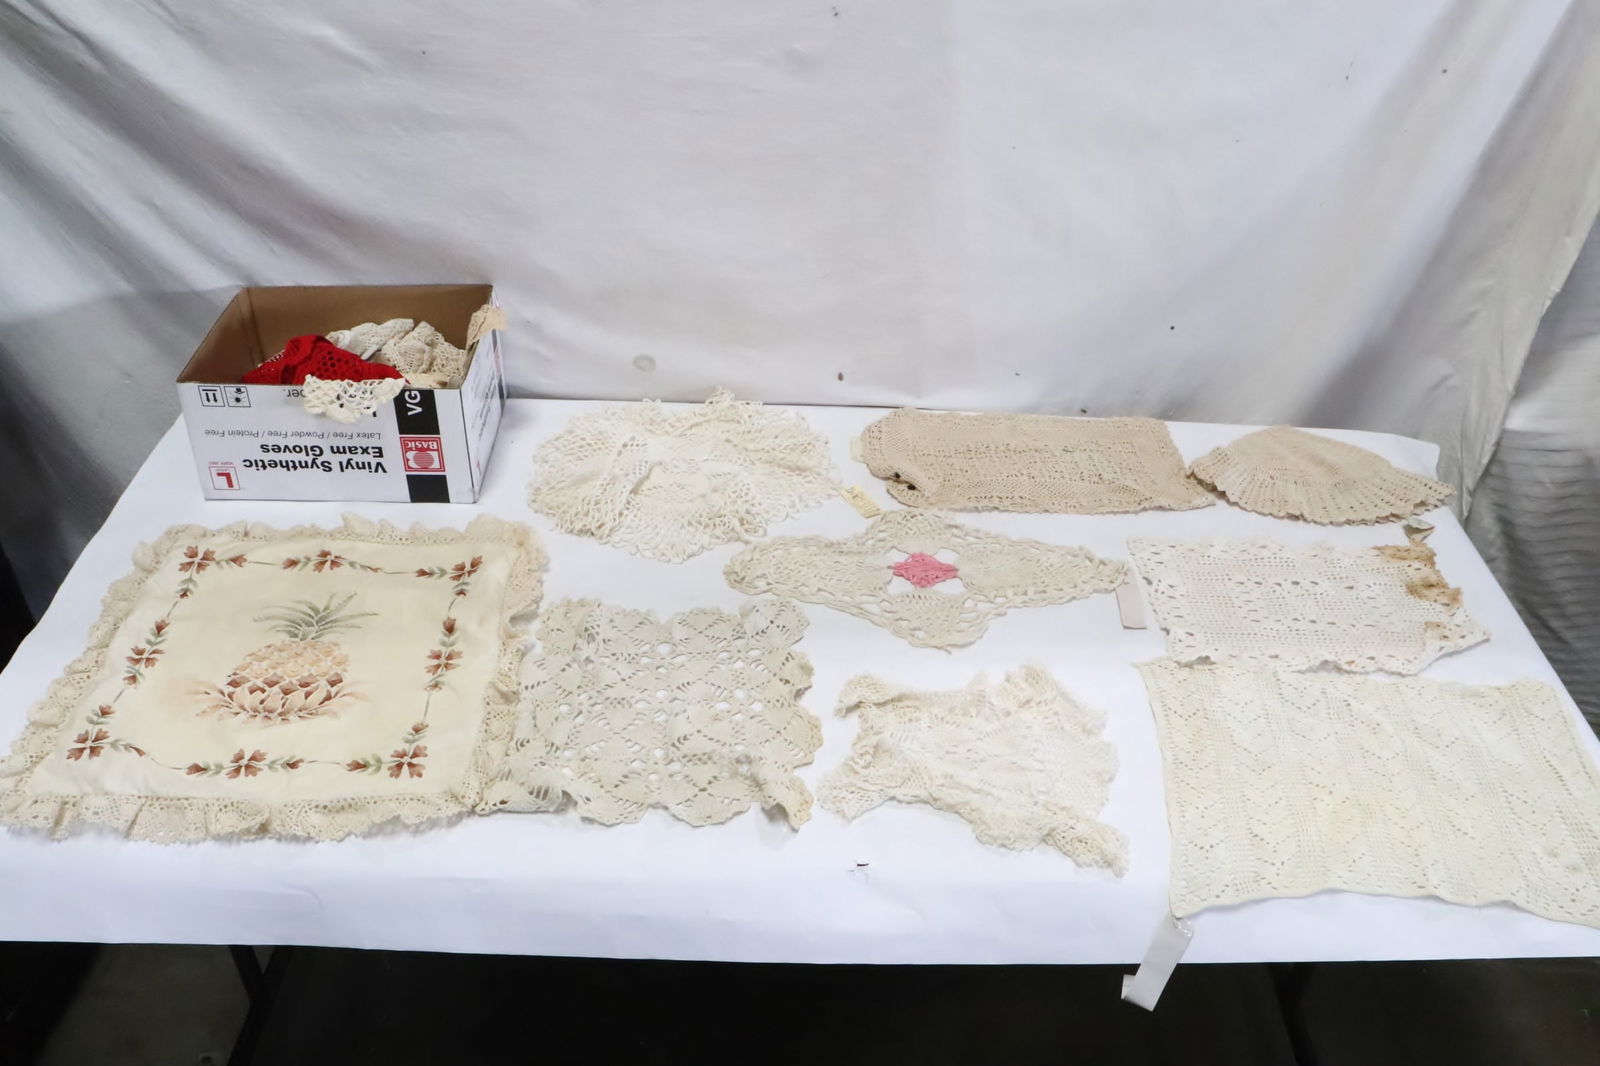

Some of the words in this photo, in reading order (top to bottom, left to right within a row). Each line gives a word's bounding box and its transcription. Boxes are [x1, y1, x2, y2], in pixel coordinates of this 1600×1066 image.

[405, 390, 422, 416] VG
[204, 429, 226, 438] Free
[227, 429, 260, 439] Protein
[267, 430, 288, 439] Free
[290, 430, 325, 440] Powder
[332, 431, 354, 440] Free
[356, 432, 381, 441] Latex
[259, 443, 325, 458] Gloves
[329, 445, 385, 460] Exam
[242, 456, 334, 472] Synthetic
[337, 459, 388, 474] Vinyl
[216, 472, 235, 489] L
